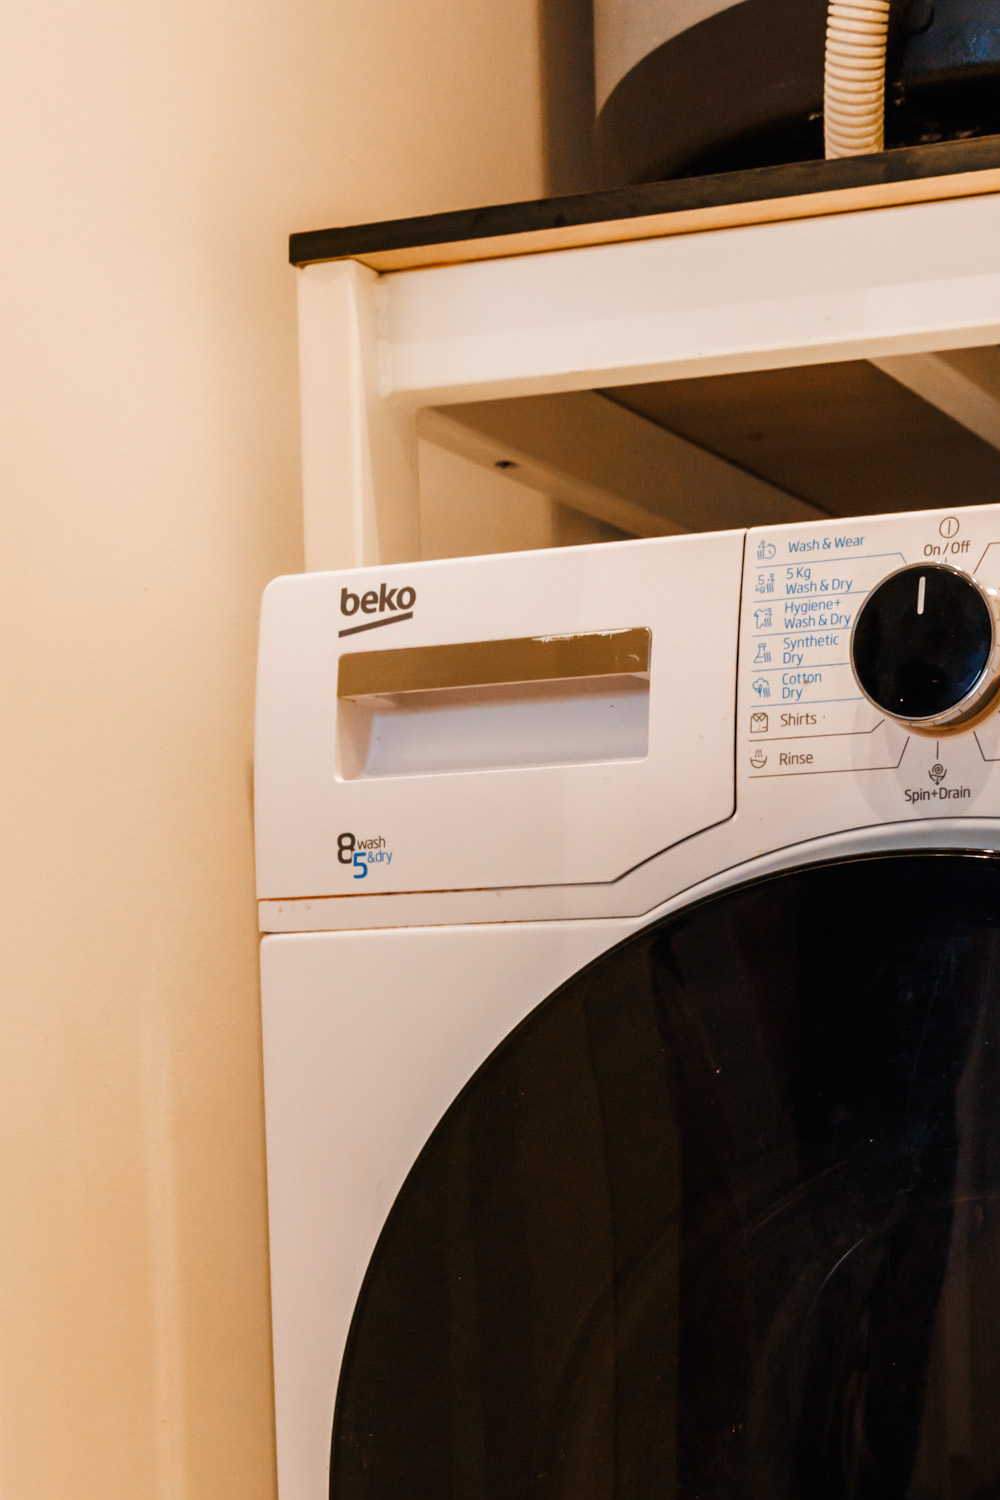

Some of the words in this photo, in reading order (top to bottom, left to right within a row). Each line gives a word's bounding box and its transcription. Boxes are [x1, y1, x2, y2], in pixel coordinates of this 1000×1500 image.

[788, 539, 820, 553] Wash
[822, 537, 832, 550] &
[834, 536, 866, 548] Wear
[786, 567, 794, 580] 5
[796, 567, 811, 580] Kg
[785, 581, 817, 595] Wash
[819, 579, 829, 591] &
[831, 579, 853, 592] Dry
[340, 583, 417, 617] beko
[784, 599, 841, 616] Hygiene+
[784, 615, 816, 629] Wash
[818, 614, 828, 626] &
[830, 613, 852, 627] Dry
[783, 633, 839, 652] Synthetic
[783, 652, 804, 666] Dry
[782, 672, 822, 686] Cotton
[782, 687, 803, 701] Dry
[780, 713, 817, 727] Shirts
[779, 752, 814, 766] Rinse
[904, 786, 971, 804] Spin+Drain
[337, 832, 356, 864] 8
[357, 835, 386, 850] wash
[353, 851, 368, 879] 5
